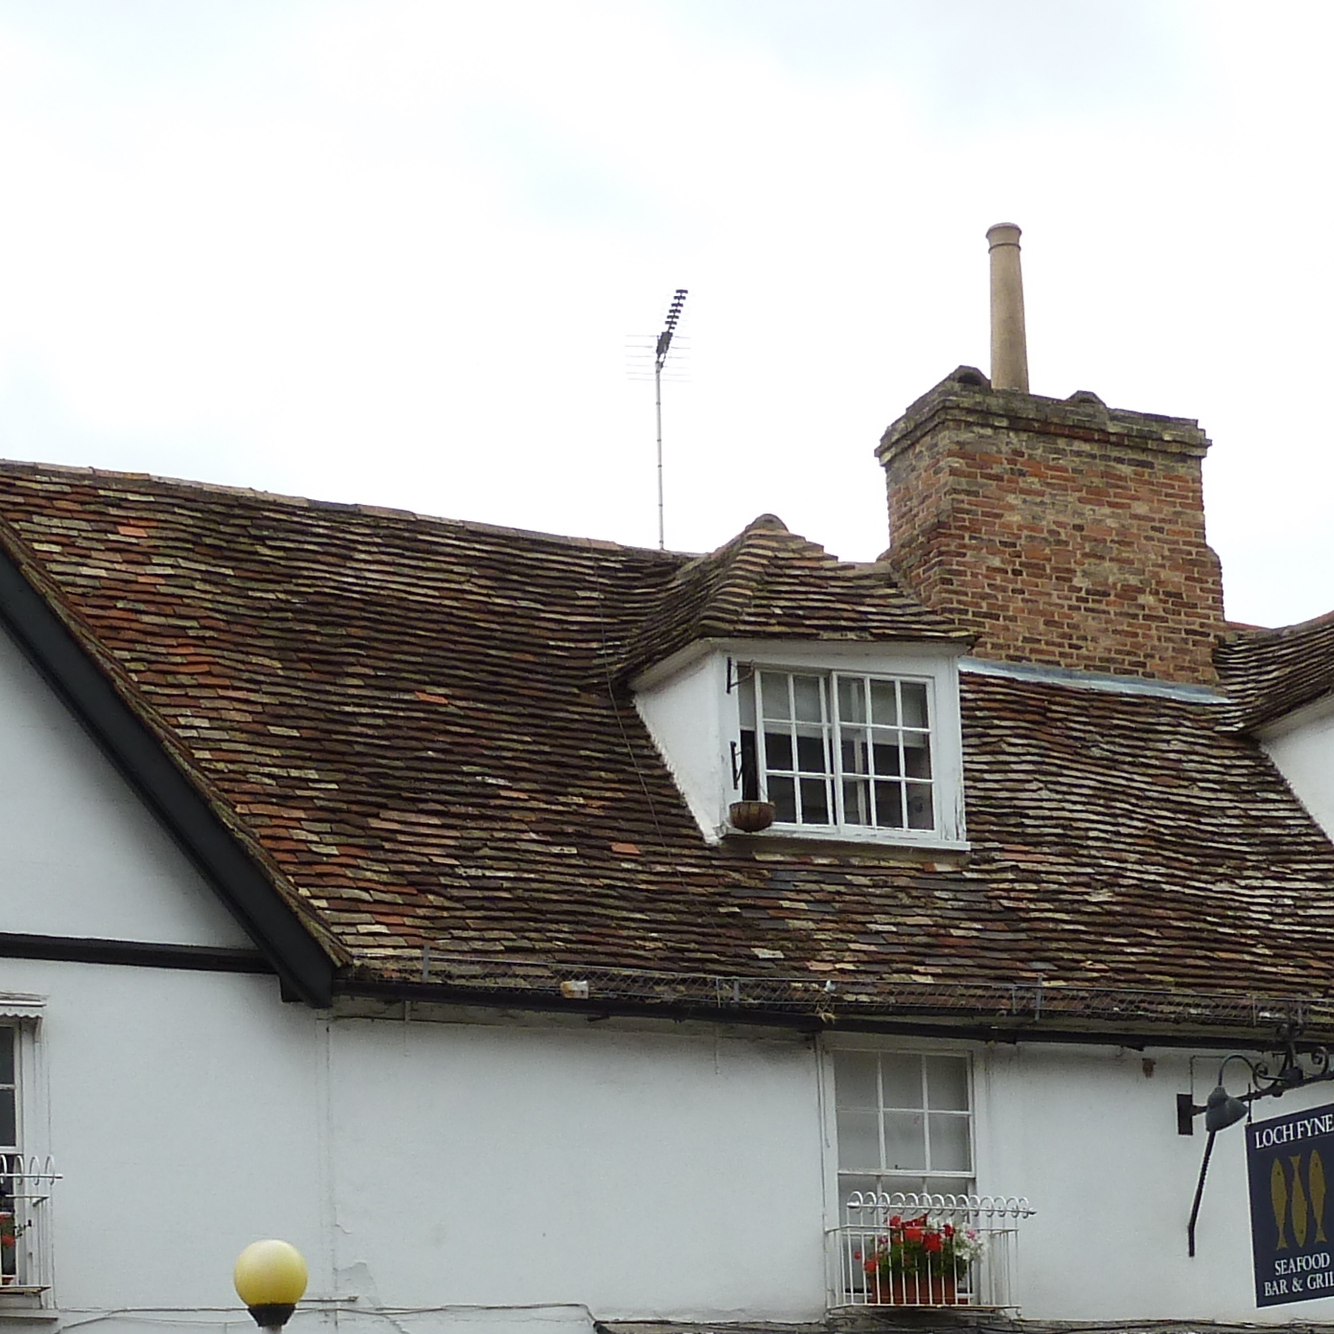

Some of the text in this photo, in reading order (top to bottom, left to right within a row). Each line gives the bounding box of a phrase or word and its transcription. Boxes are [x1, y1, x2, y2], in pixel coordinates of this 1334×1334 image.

[1255, 1114, 1334, 1149] LOCH FYNE
[1274, 1252, 1330, 1275] SEAFOOD
[1264, 1280, 1289, 1297] BAR
[1291, 1277, 1303, 1292] &
